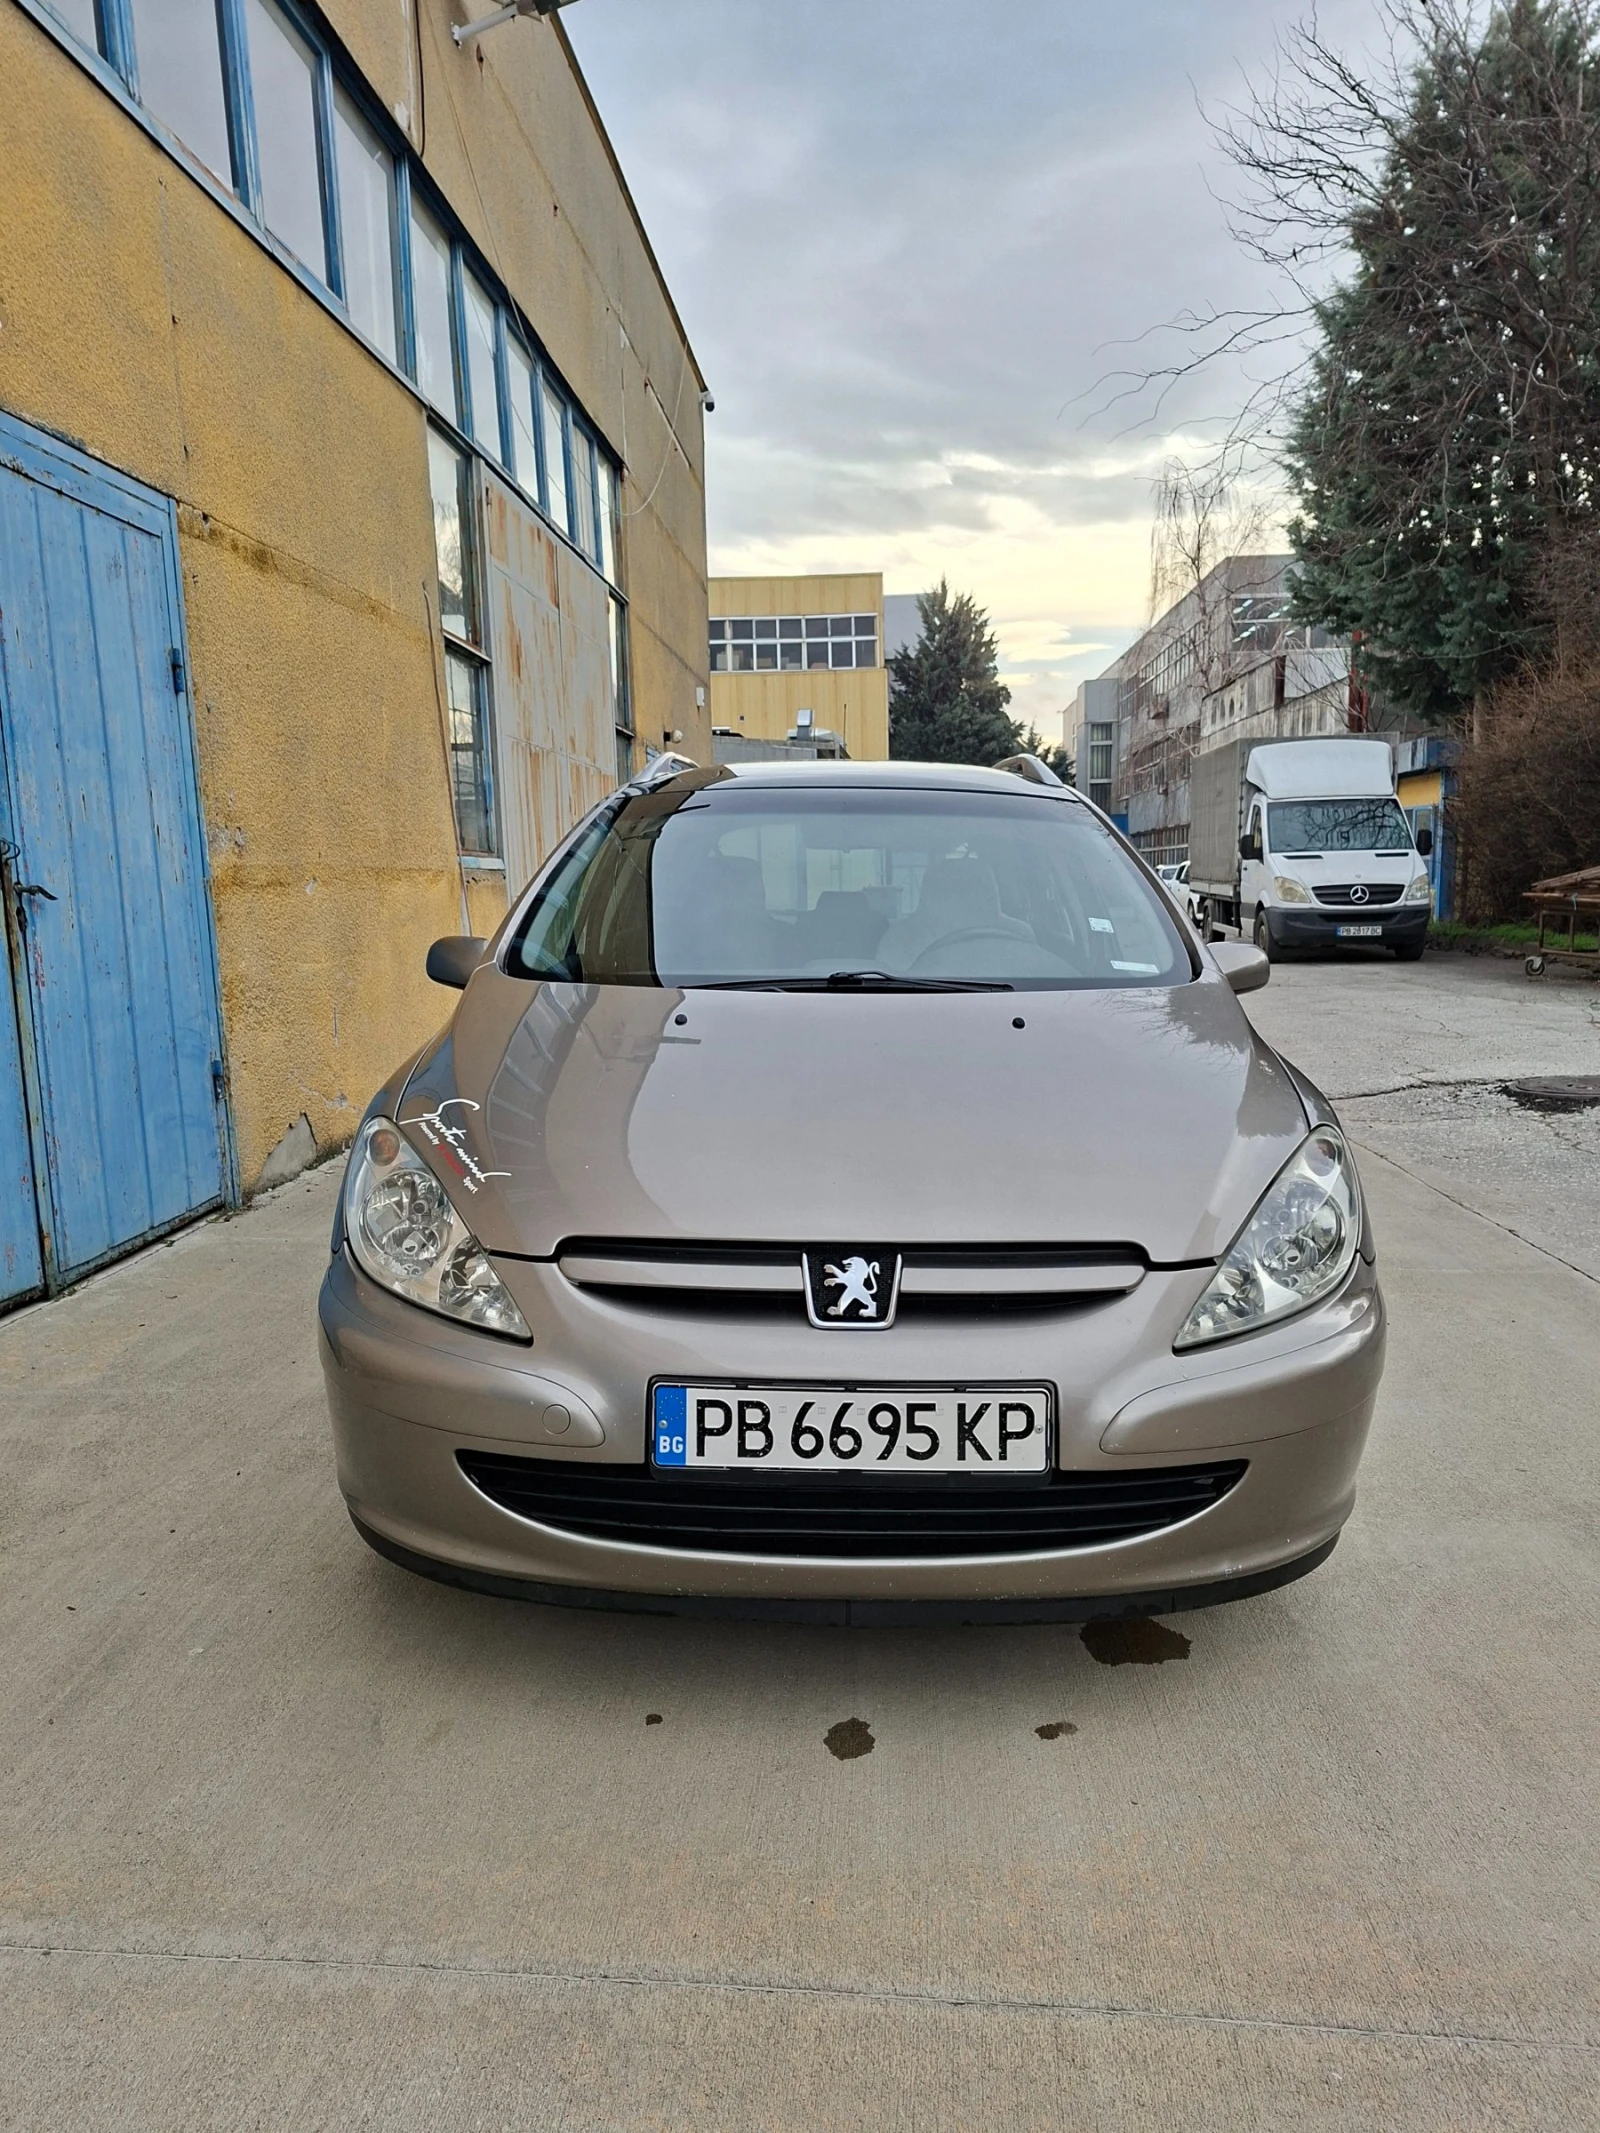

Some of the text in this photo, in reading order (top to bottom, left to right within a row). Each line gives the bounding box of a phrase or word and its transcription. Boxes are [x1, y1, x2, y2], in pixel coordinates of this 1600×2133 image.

[463, 1176, 479, 1194] Sport
[696, 1398, 1036, 1461] PB 6695 KP
[659, 1435, 684, 1454] BG
